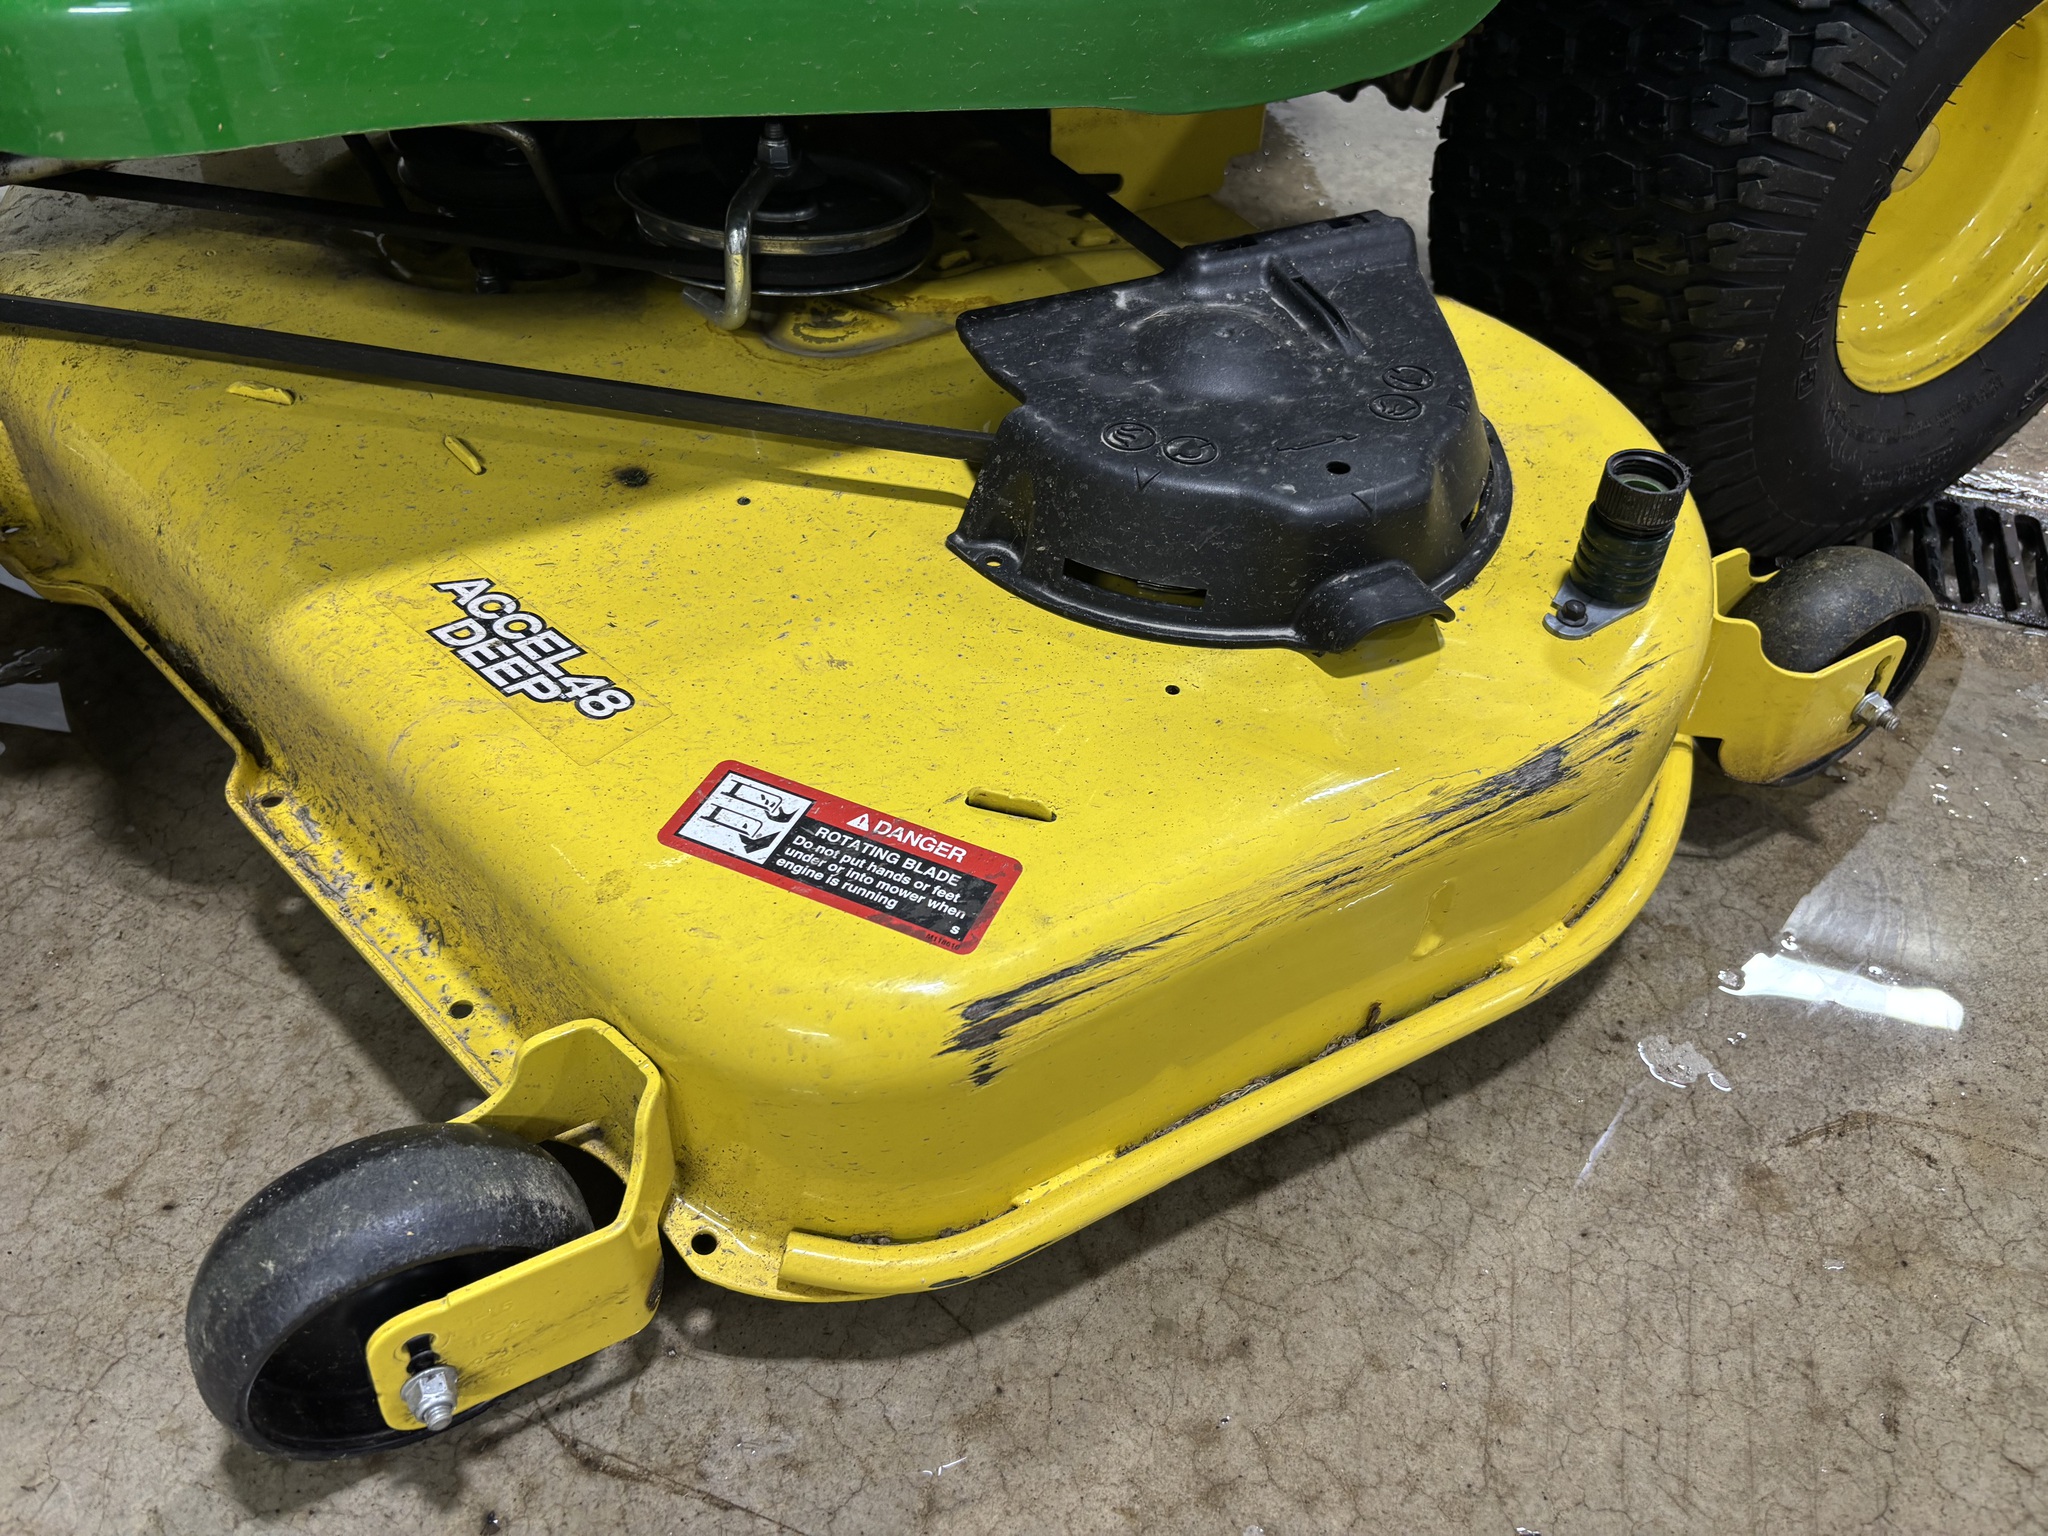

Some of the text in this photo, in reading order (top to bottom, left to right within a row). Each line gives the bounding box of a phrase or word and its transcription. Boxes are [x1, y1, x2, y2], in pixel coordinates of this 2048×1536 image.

[429, 617, 562, 701] DEEP
[432, 578, 586, 679] ACCEL
[557, 677, 634, 718] 48
[792, 835, 961, 904] Do not put hands or feet
[814, 826, 962, 887] ROTATING BLADE
[874, 820, 967, 863] DANGER
[776, 858, 898, 910] engine is running
[784, 847, 967, 919] under or into mower when
[949, 924, 960, 935] s
